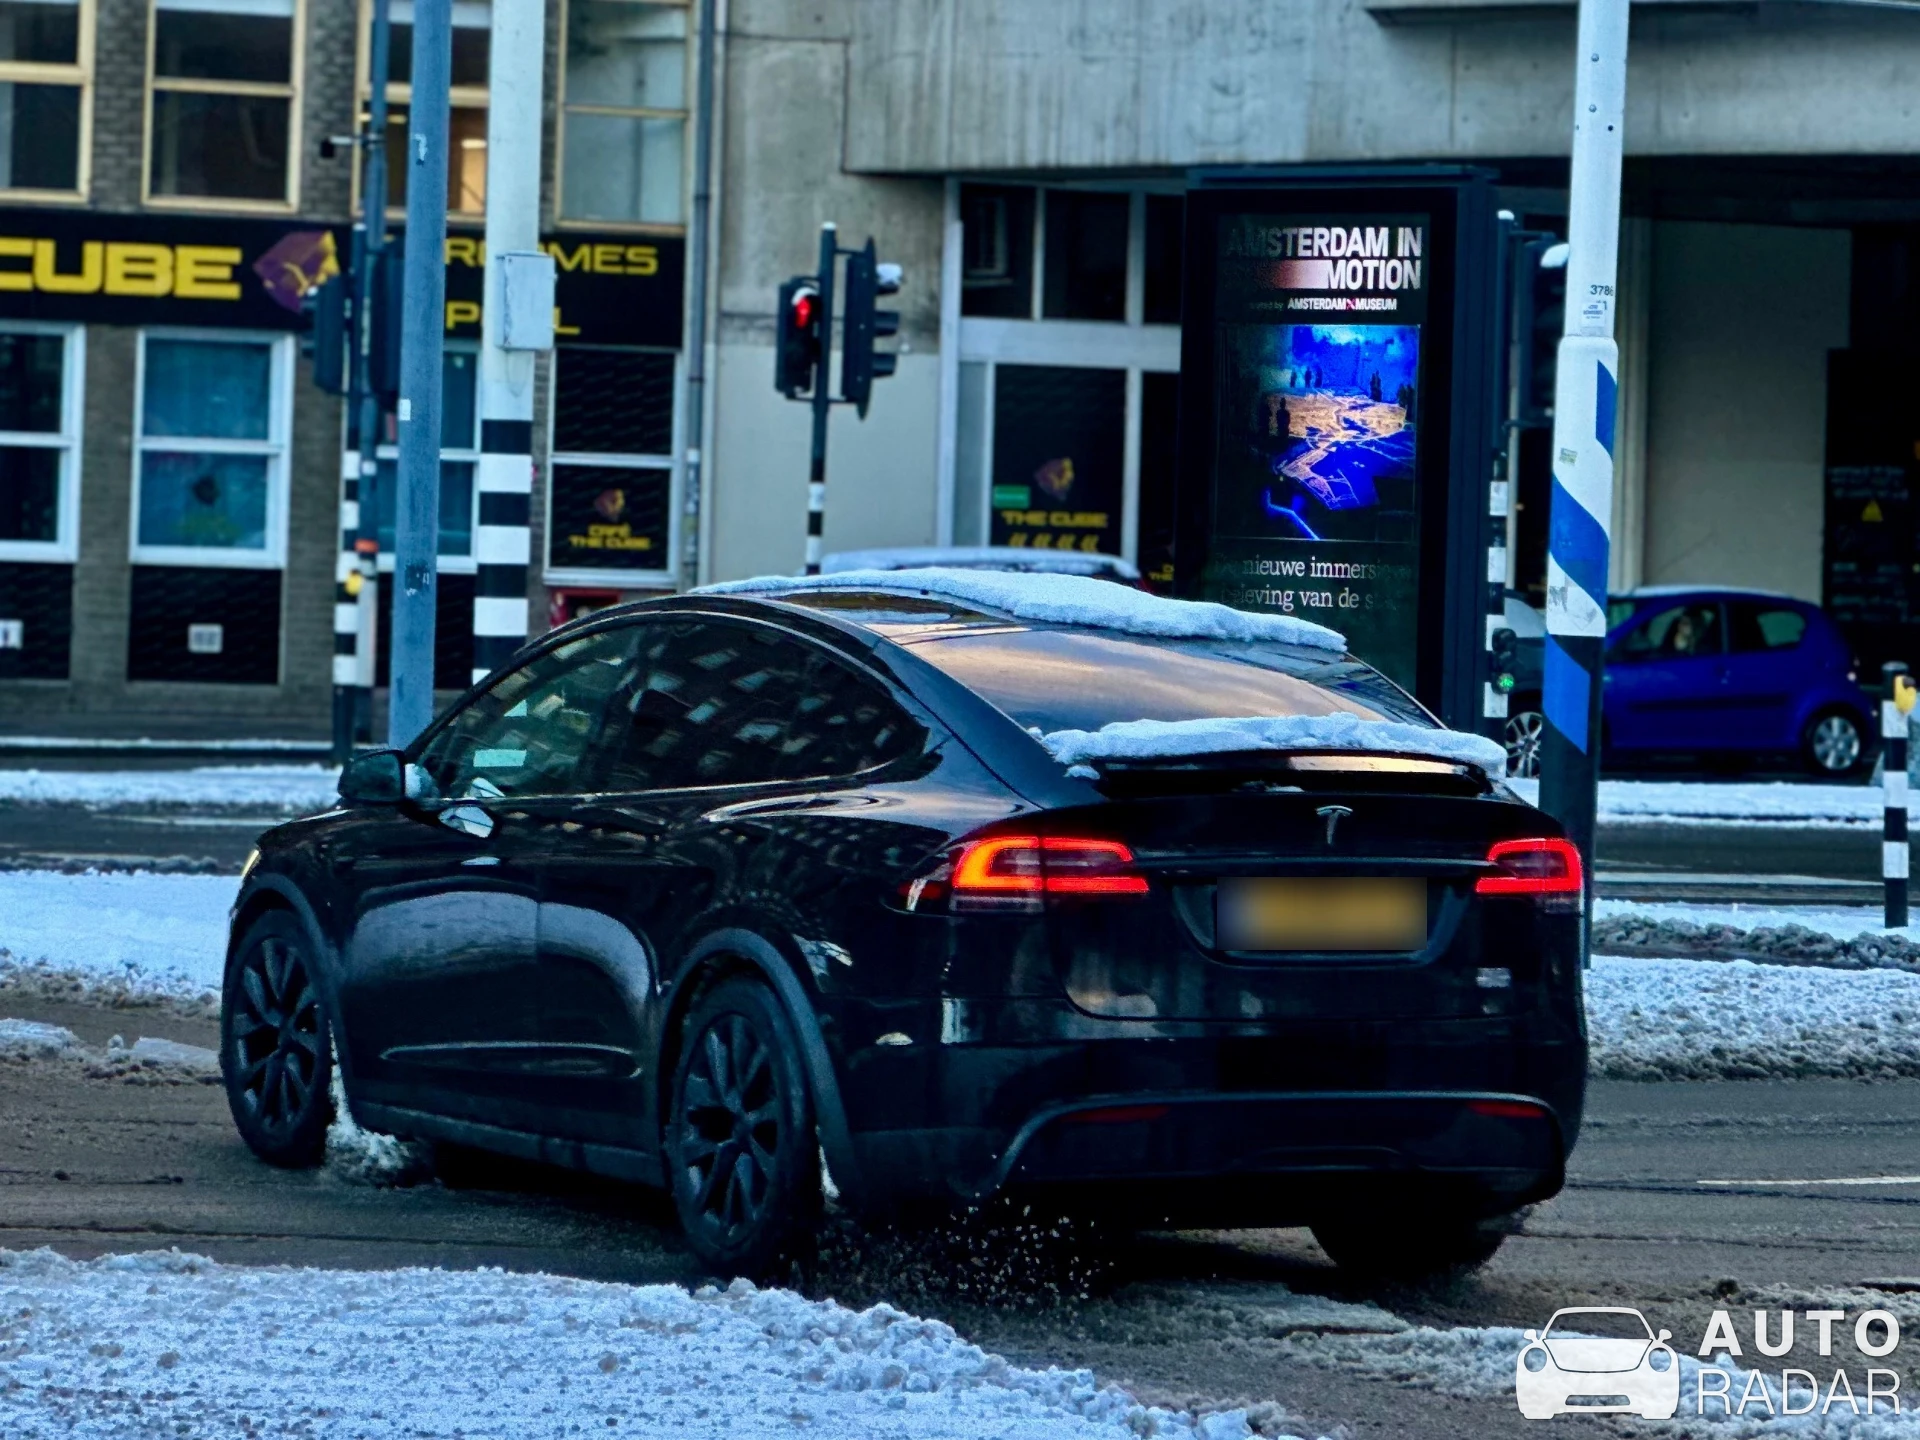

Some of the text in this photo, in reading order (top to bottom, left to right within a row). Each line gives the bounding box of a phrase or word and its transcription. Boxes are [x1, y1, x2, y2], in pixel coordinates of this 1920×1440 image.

[1225, 226, 1423, 258] AMSTERDAM IN
[1327, 258, 1422, 290] MOTION
[446, 301, 581, 335] PL
[1002, 510, 1109, 528] THE CUBE
[1243, 554, 1306, 578] nieuwe
[1310, 556, 1408, 581] immersi
[1299, 592, 1334, 608] van
[1339, 587, 1360, 609] de
